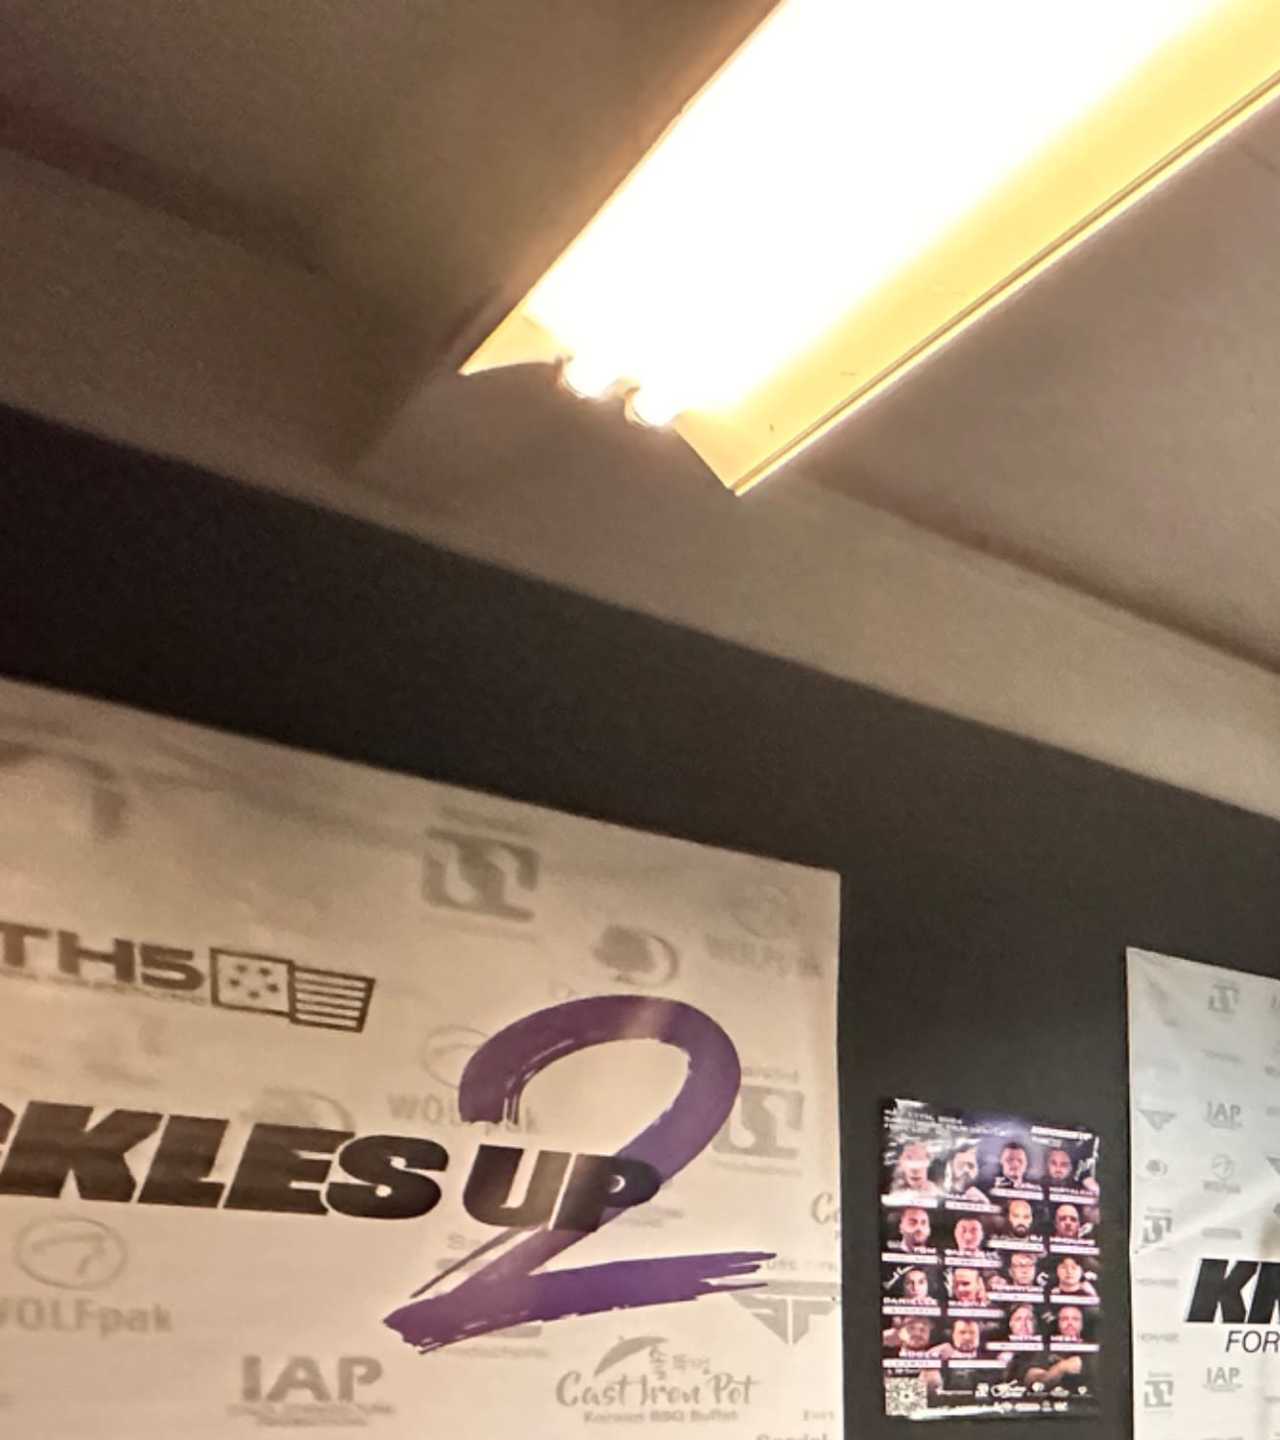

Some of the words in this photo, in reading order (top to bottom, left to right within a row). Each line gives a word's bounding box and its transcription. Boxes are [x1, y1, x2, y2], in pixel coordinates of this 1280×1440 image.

[0, 1100, 449, 1219] KLES
[463, 1144, 661, 1232] UP
[382, 995, 777, 1354] 2
[1226, 1330, 1280, 1353] FOR
[243, 1355, 383, 1402] IAP
[555, 1370, 638, 1407] Cast
[639, 1374, 700, 1405] Iron
[706, 1372, 763, 1404] Pot
[1207, 1367, 1240, 1384] IAP
